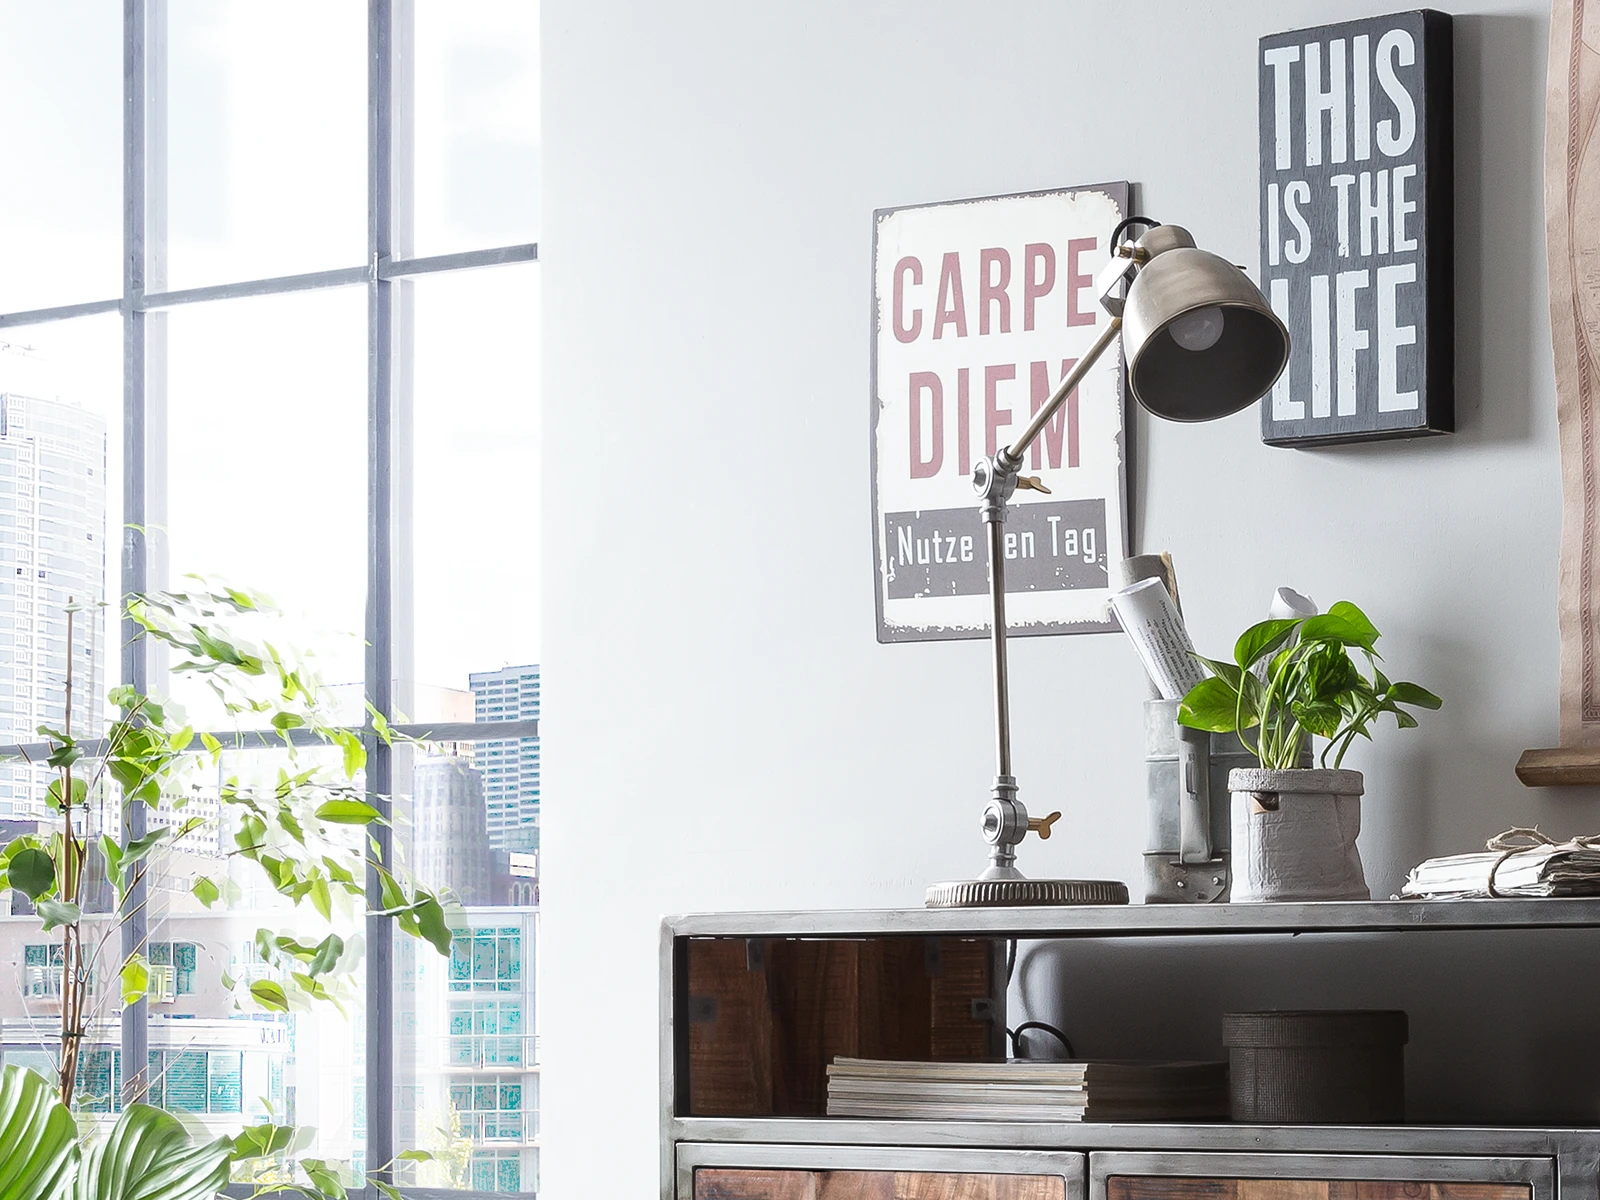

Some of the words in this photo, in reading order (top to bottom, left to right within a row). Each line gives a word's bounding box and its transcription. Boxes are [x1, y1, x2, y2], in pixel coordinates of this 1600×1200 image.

[1265, 28, 1417, 171] THIS
[1268, 180, 1311, 267] IS
[1330, 164, 1418, 259] THE
[892, 236, 1098, 344] CARPE
[1270, 263, 1419, 422] LIFE
[908, 358, 1081, 480] DIEM
[898, 525, 974, 566] Nutze
[1047, 515, 1096, 564] Tag
